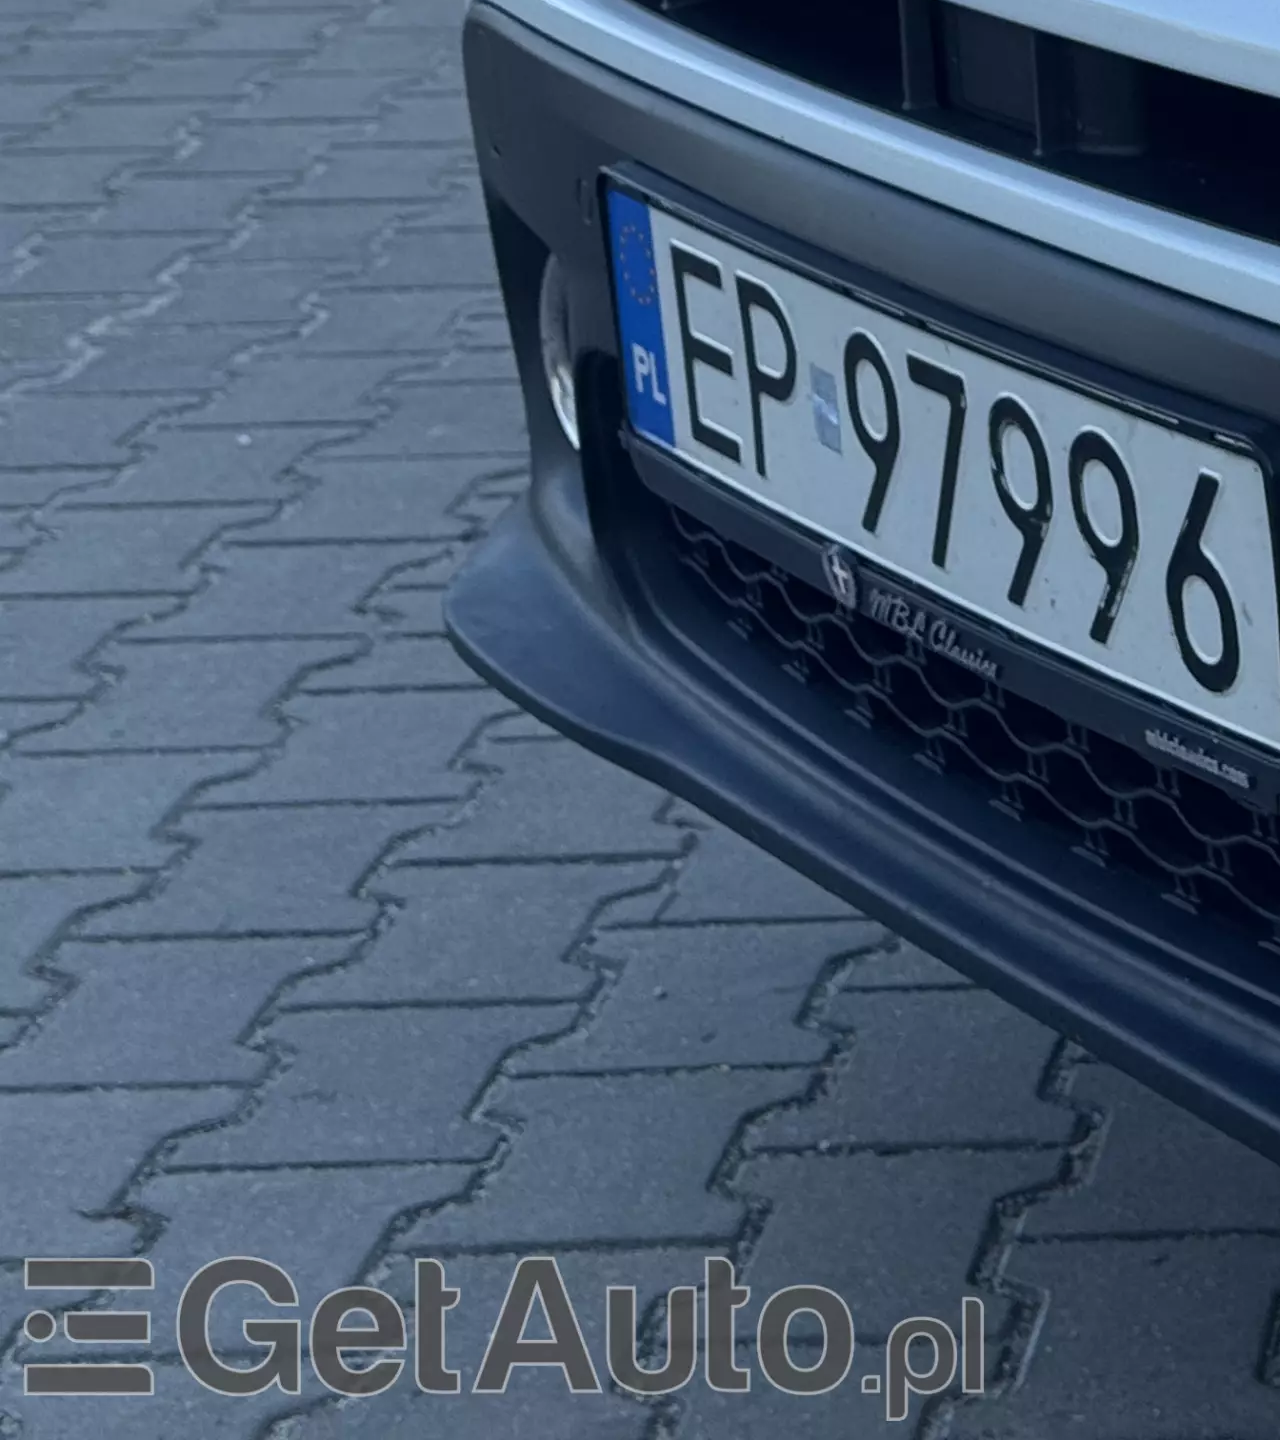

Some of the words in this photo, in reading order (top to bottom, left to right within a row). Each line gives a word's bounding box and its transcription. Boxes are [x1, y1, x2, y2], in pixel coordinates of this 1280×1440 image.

[631, 342, 667, 406] PL
[670, 239, 797, 479] EP
[843, 330, 1241, 694] 97996
